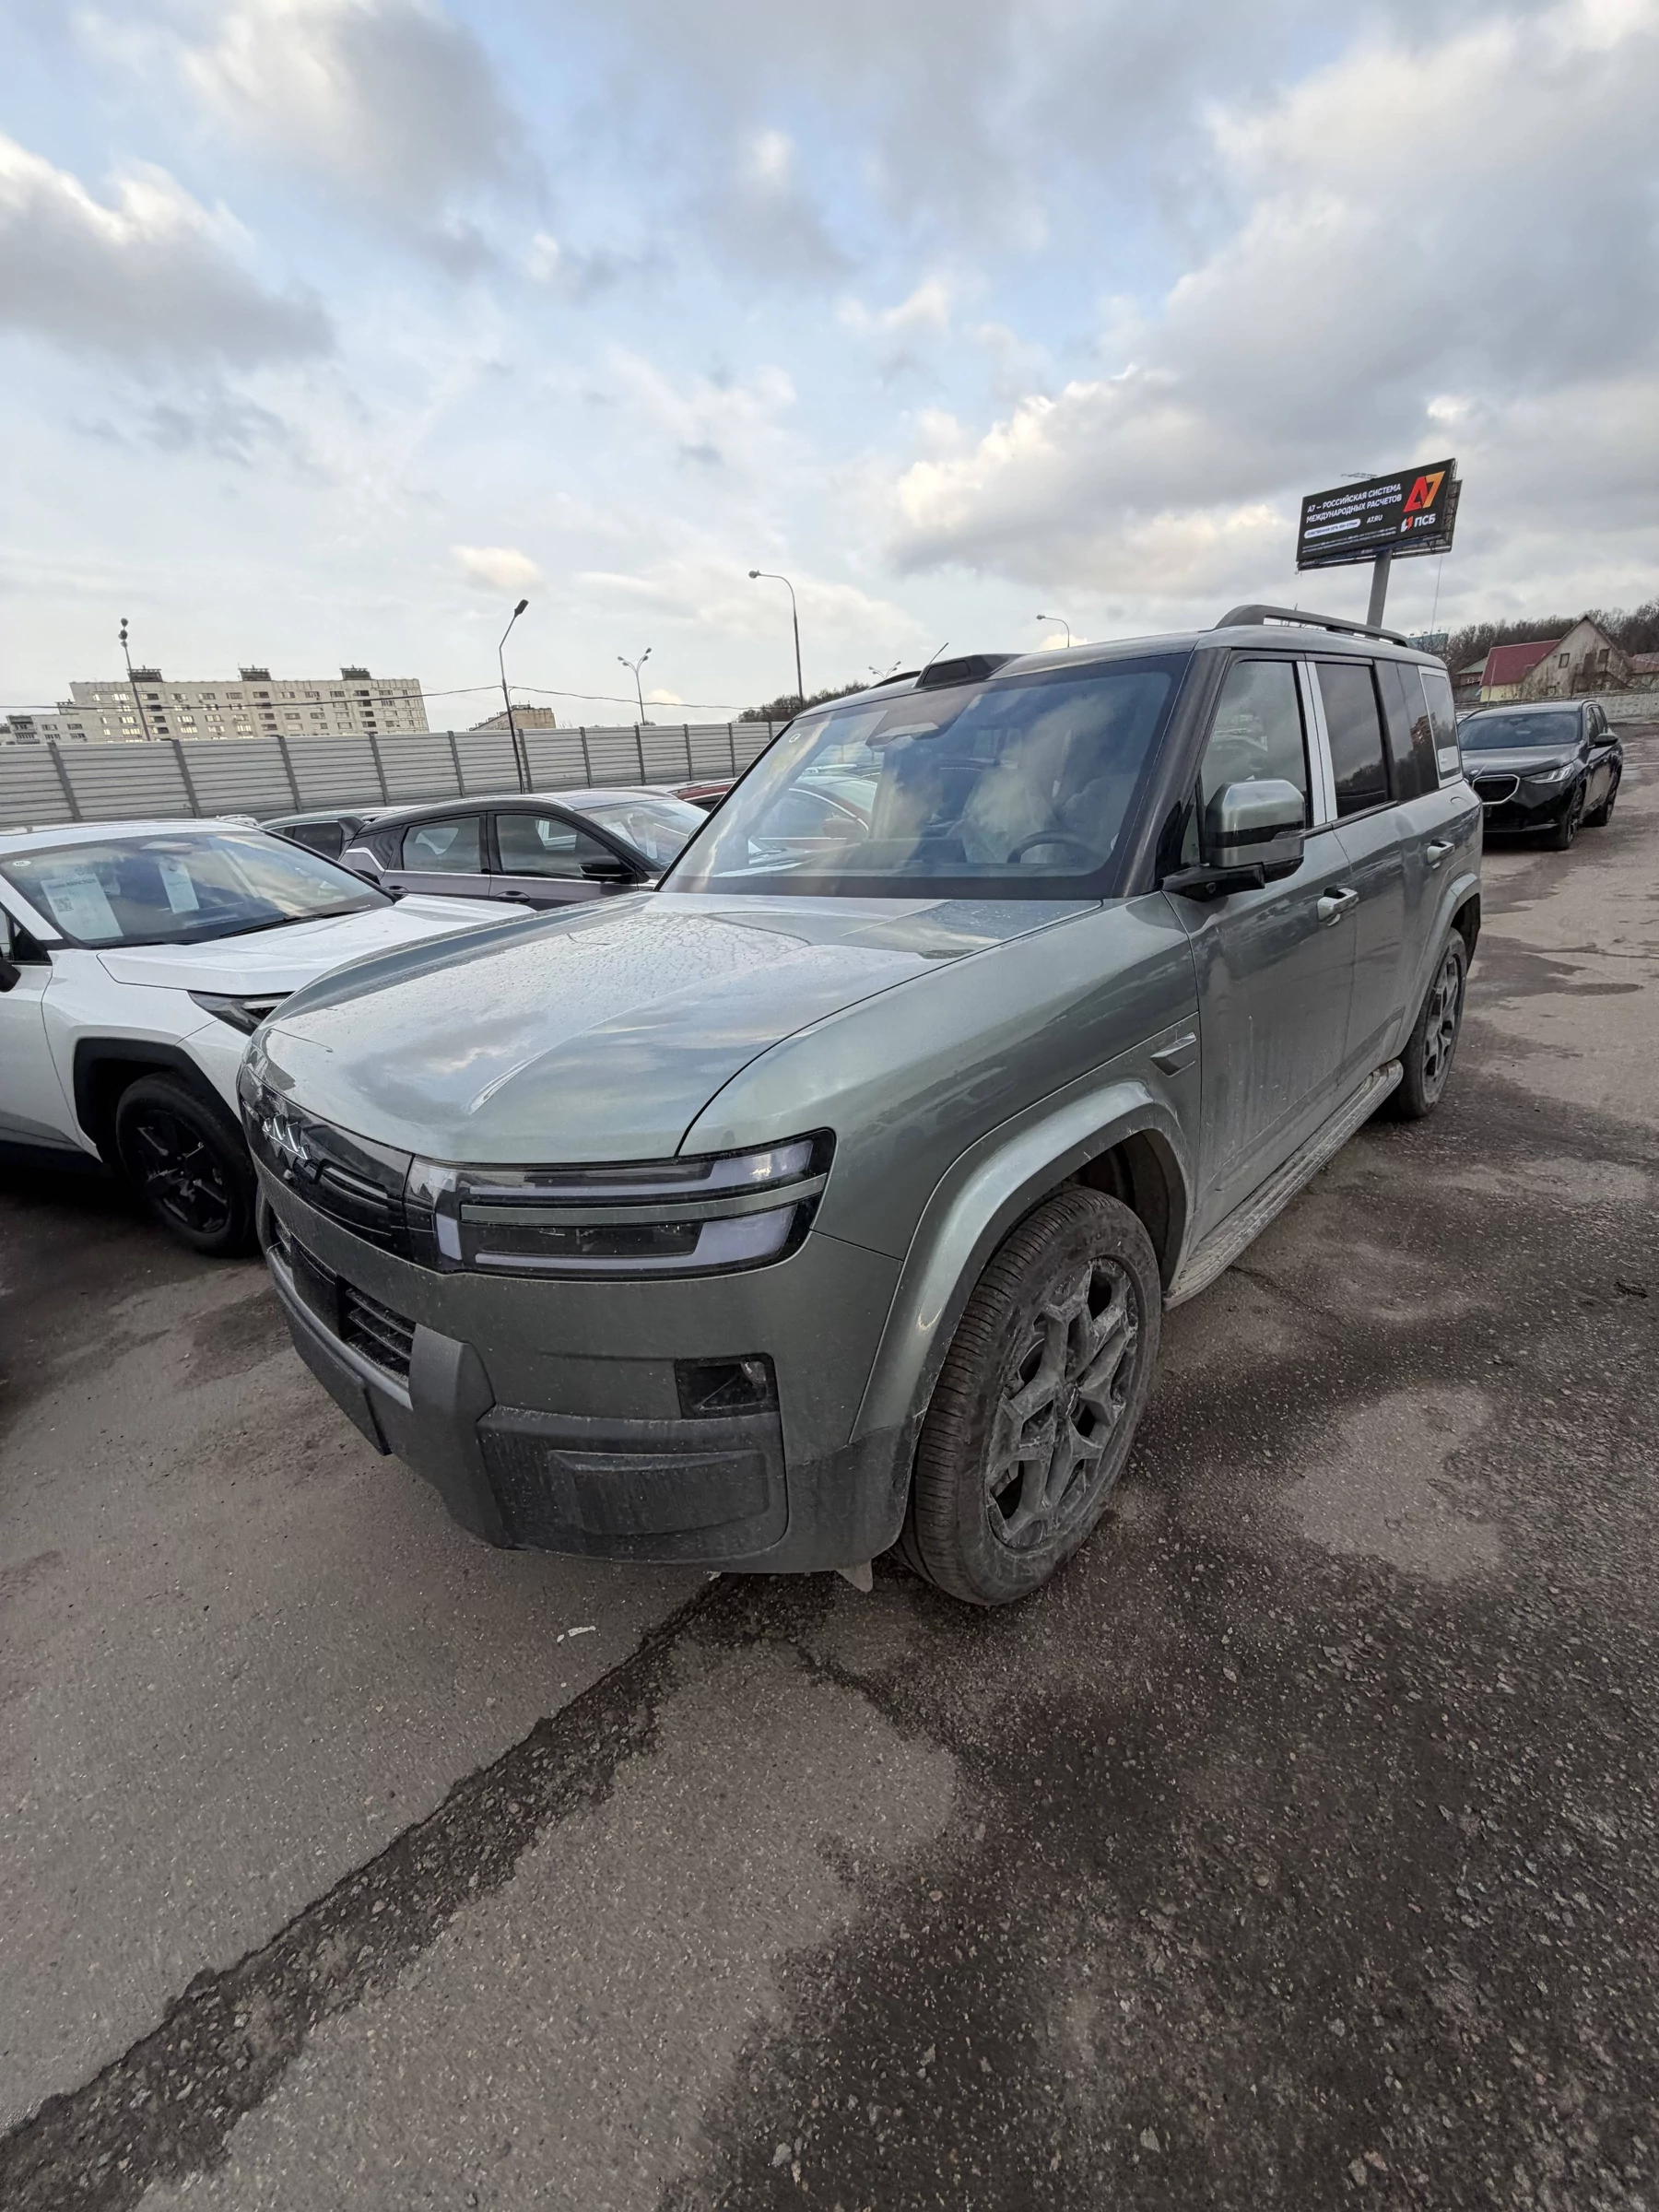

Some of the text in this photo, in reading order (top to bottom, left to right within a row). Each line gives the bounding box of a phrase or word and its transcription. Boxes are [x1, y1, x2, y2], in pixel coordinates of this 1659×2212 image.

[1306, 493, 1403, 524] МЕЖДУНАРОДНЫХ РАСЧЕТОВ
[1322, 491, 1367, 510] РОССИЙСКАЯ
[1368, 483, 1402, 499] СИСТЕМА
[1414, 513, 1436, 528] ПСБ
